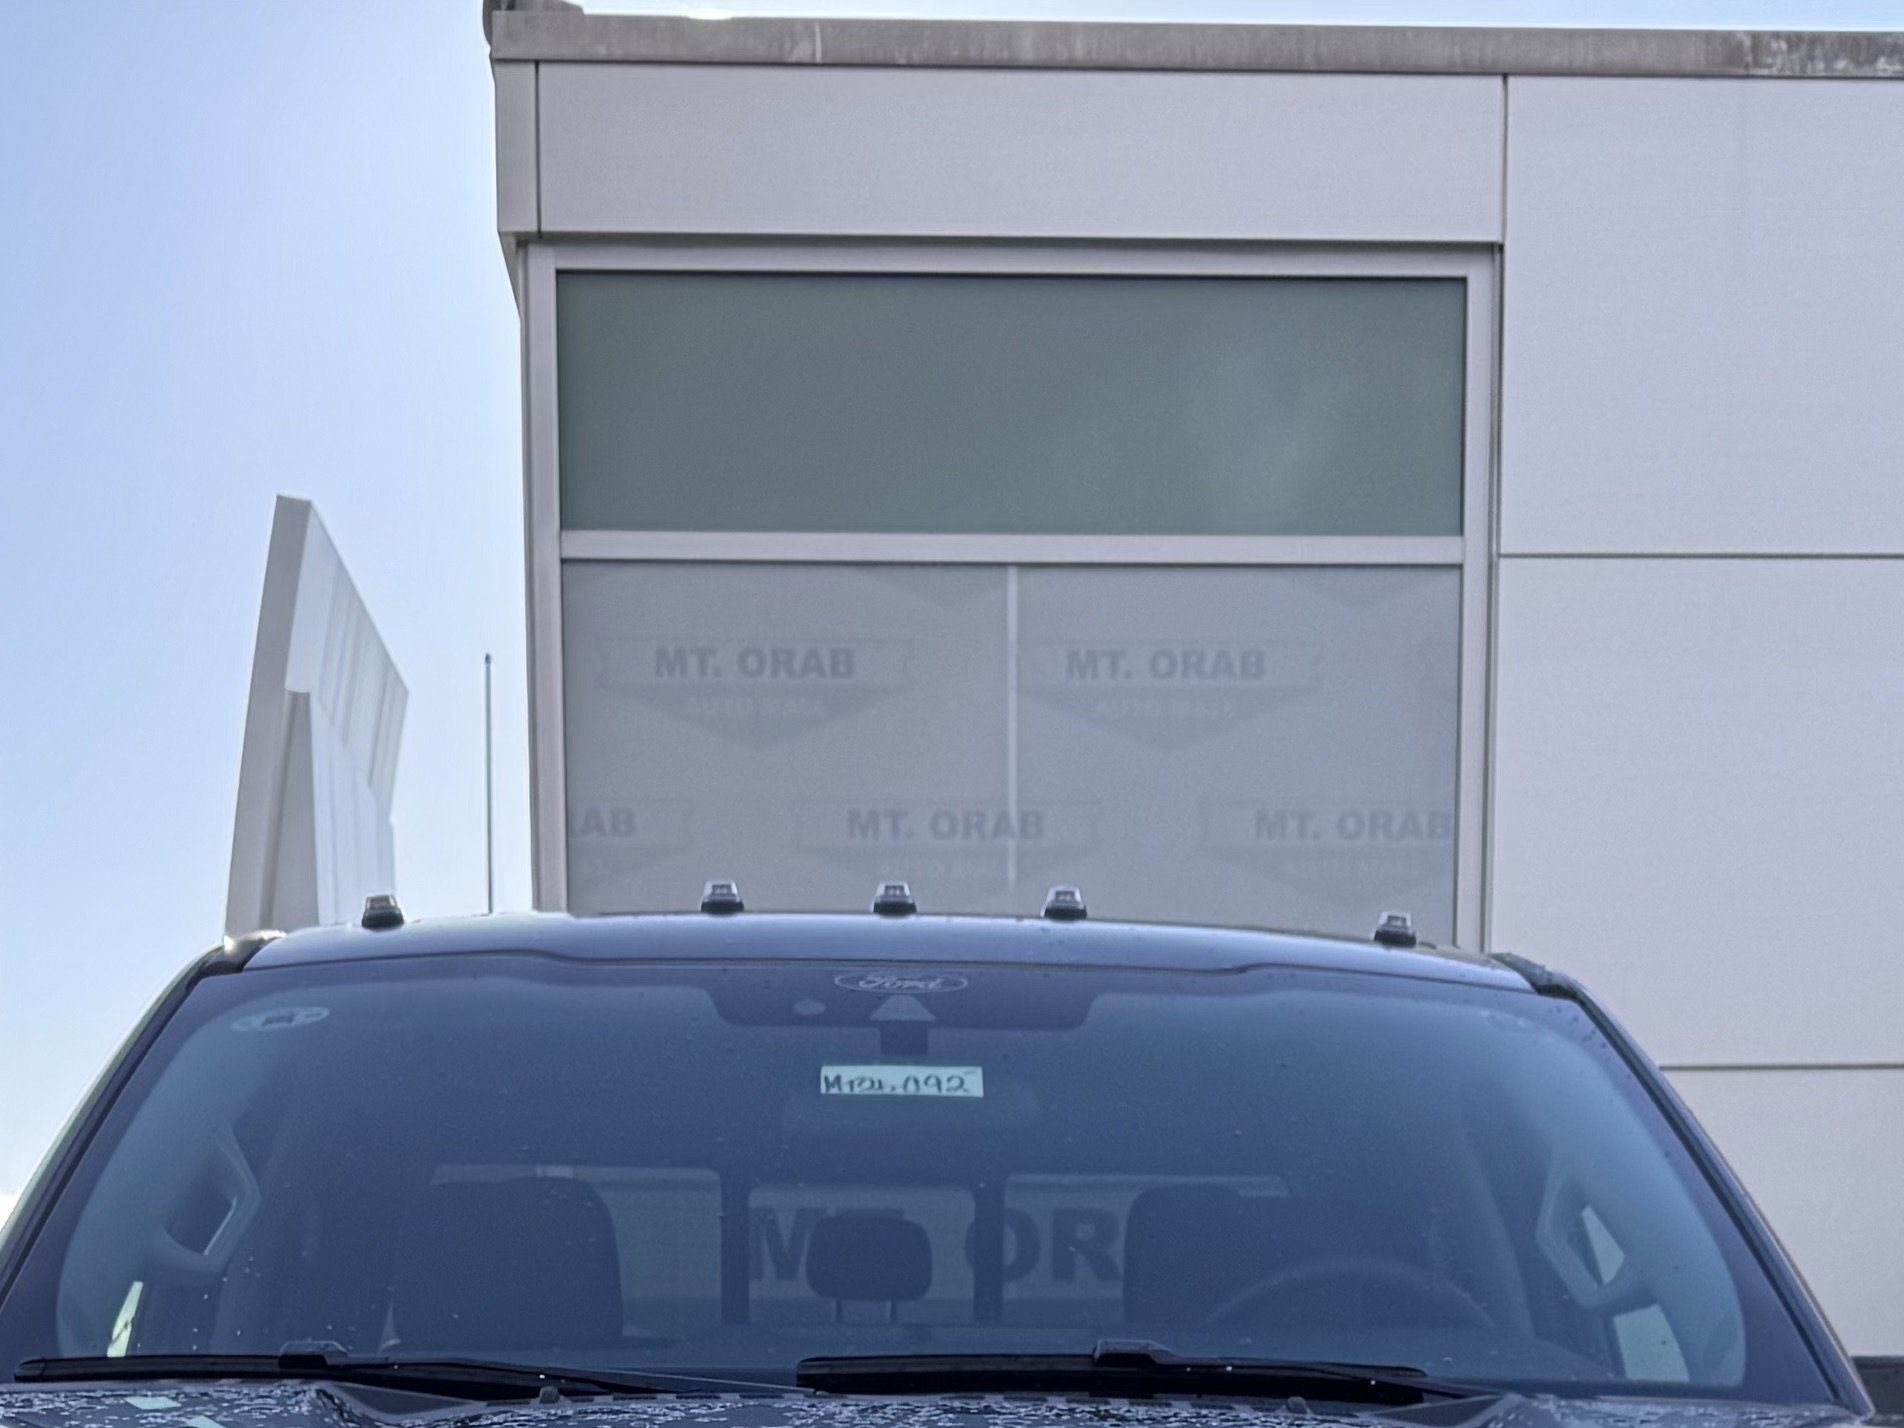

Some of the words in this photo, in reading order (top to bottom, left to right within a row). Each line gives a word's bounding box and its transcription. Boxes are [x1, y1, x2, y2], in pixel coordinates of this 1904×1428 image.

[655, 647, 722, 678] MT.
[737, 647, 855, 679] ORAB
[1066, 649, 1132, 680] MT.
[1149, 649, 1266, 680] ORAB
[848, 809, 915, 839] MT.
[1255, 810, 1320, 840] MT.
[1336, 810, 1452, 840] ORAB
[858, 974, 945, 991] Ford
